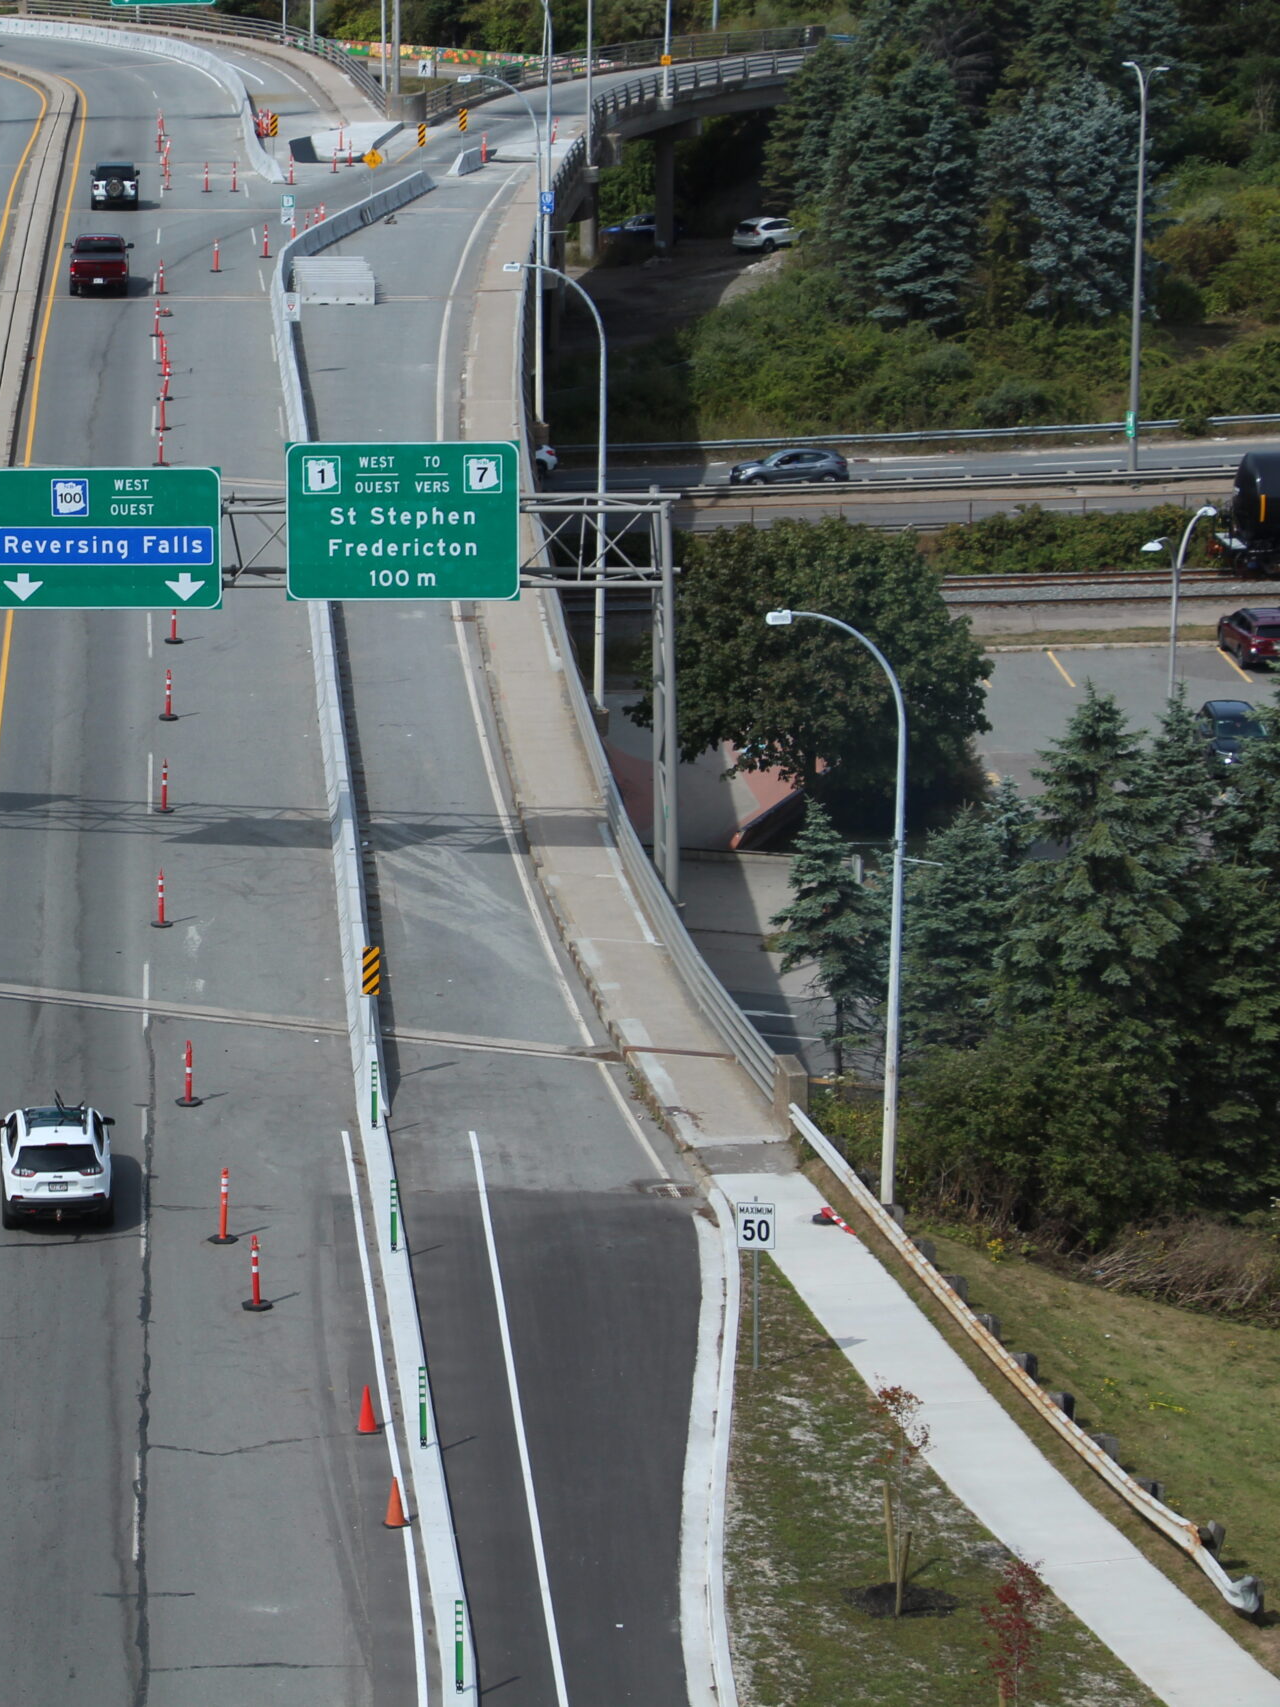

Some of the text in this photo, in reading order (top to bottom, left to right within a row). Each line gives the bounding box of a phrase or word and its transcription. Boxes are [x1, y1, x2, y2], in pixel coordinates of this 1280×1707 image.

[358, 456, 395, 468] WEST
[423, 456, 440, 468] TO
[317, 468, 325, 484] 1
[476, 467, 488, 483] 7
[114, 479, 149, 491] WEST
[354, 481, 400, 493] OUEST
[415, 481, 450, 493] VERS
[58, 492, 82, 504] 100
[110, 504, 154, 515] OUEST
[330, 507, 476, 529] St Stephen
[4, 535, 203, 559] Reversing Falls
[328, 538, 478, 557] Fredericton
[369, 569, 437, 587] 100 m
[739, 1206, 773, 1215] MAXIMUM
[742, 1219, 770, 1242] 50
